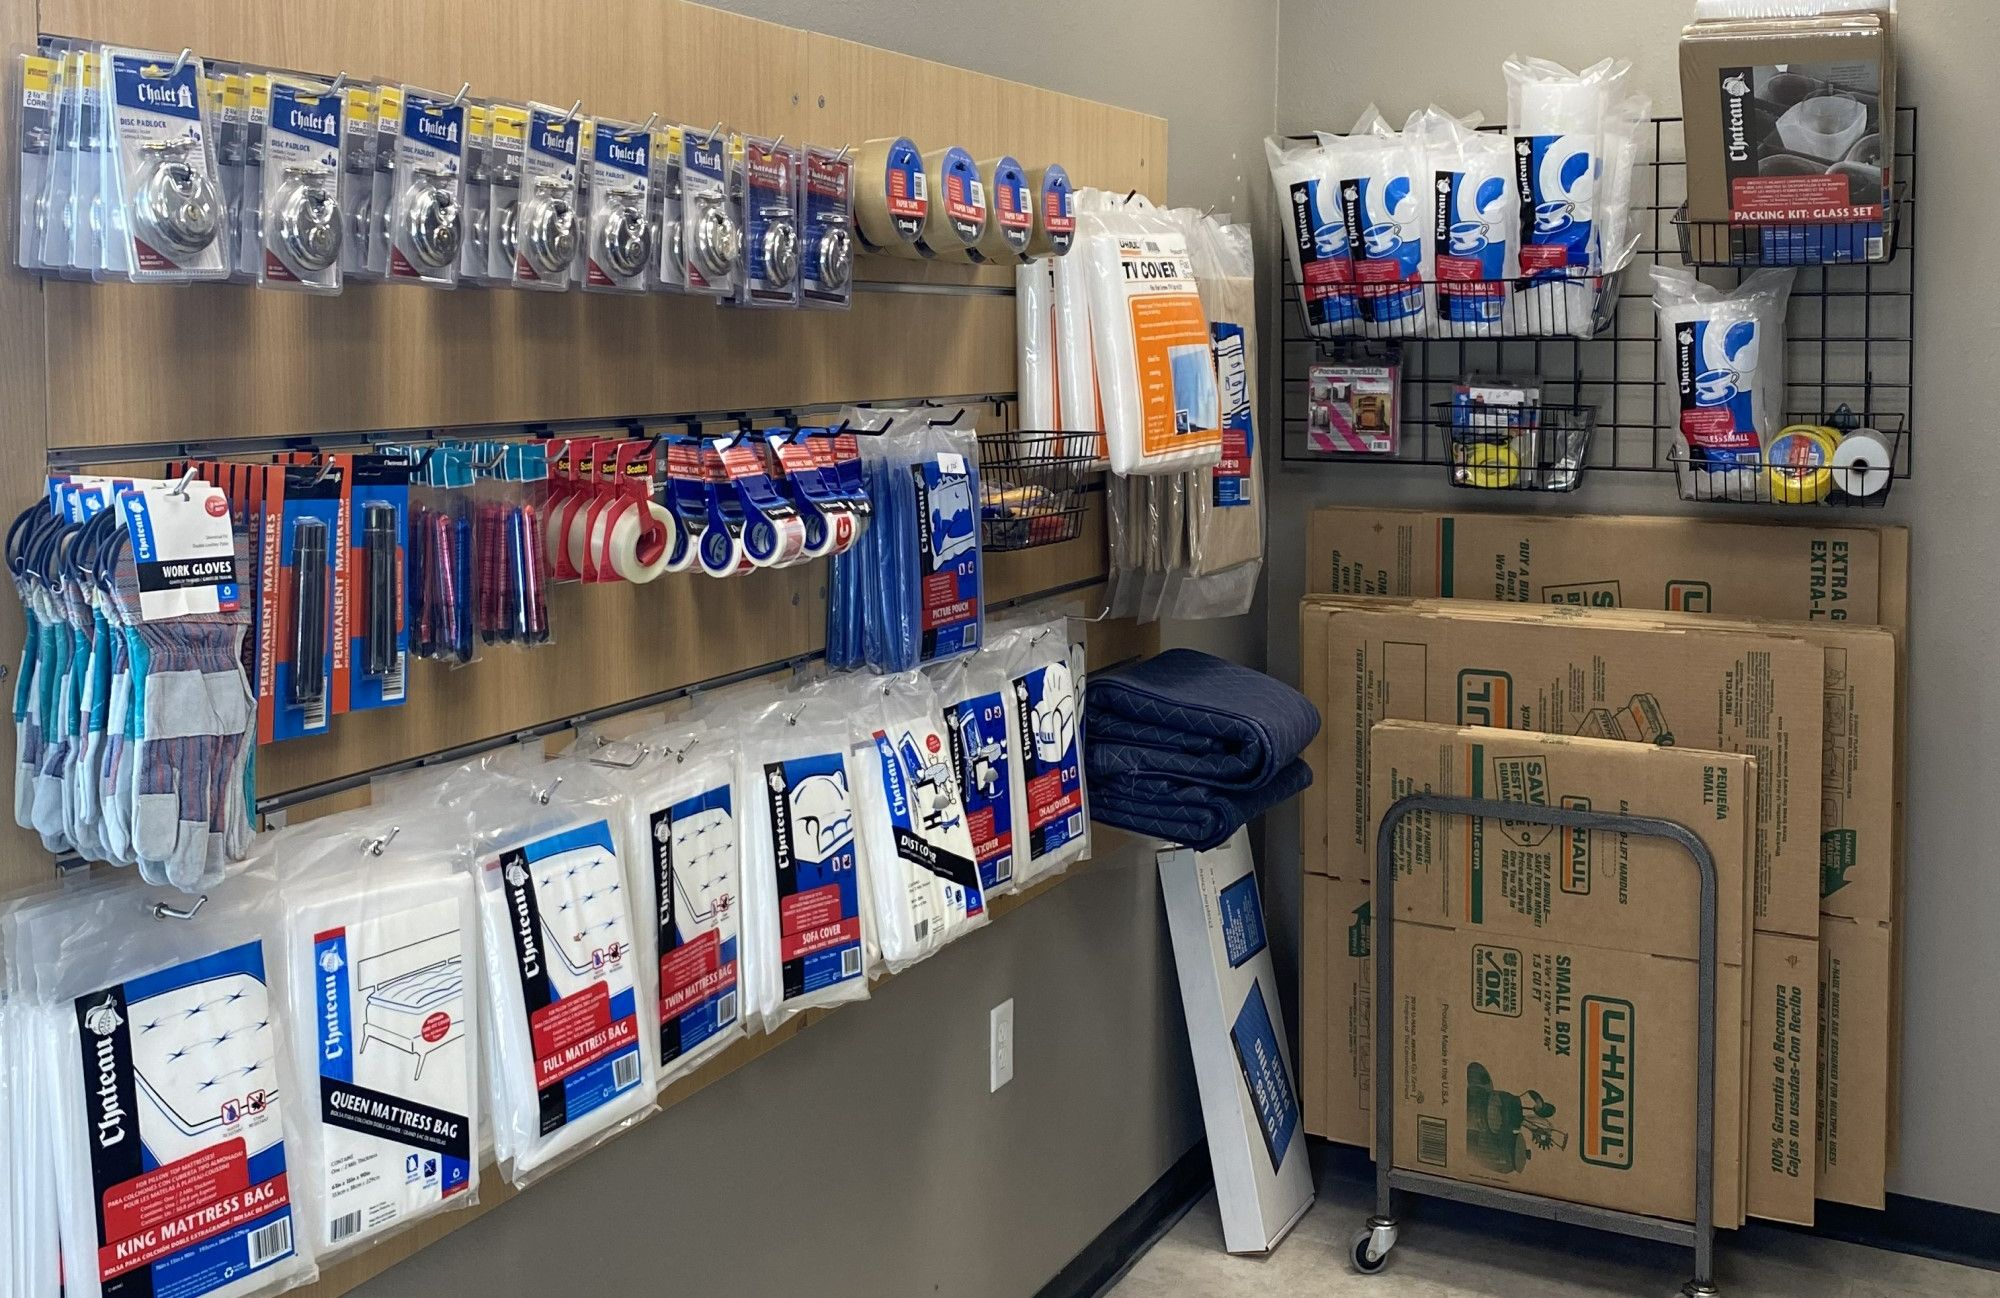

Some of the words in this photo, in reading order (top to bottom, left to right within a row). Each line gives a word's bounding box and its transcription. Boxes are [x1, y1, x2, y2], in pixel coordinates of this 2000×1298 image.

[138, 83, 177, 102] Chalet
[120, 117, 136, 126] DISC
[137, 119, 167, 128] PADLOCK
[290, 109, 322, 130] Chalet
[419, 117, 447, 136] Chalet
[1729, 98, 1749, 162] Chateau
[543, 132, 565, 150] Chalet
[609, 144, 635, 162] Chalet
[695, 152, 714, 167] Chalet
[1519, 156, 1531, 203] Chateau
[1298, 205, 1311, 250] Chateau
[1347, 202, 1360, 247] Chateau
[1436, 194, 1447, 240] Chateau
[1734, 210, 1785, 221] PACKING
[1788, 209, 1810, 219] KIT:
[1813, 208, 1850, 218] GLASS
[1853, 206, 1874, 217] SET
[1122, 262, 1139, 279] TV
[1141, 262, 1178, 279] COVER
[1681, 346, 1691, 394] Chateau
[627, 464, 648, 474] Scotch
[133, 513, 150, 560] Chateau
[335, 499, 345, 572] MARKERS
[922, 487, 930, 553] Chateau
[162, 564, 190, 578] WORK
[192, 561, 232, 576] GLOVES
[264, 513, 276, 594] MARKERS
[1496, 554, 1506, 581] We'll
[1831, 541, 1848, 602] EXTRA
[1508, 570, 1517, 591] Beat
[333, 577, 345, 670] PERMANENT
[932, 607, 951, 620] PICTURE
[951, 602, 969, 615] POUCH
[259, 598, 272, 697] PERMANENT
[1725, 671, 1733, 715] RECYCLE
[1021, 702, 1032, 761] Chateau
[887, 758, 907, 817] Chateau
[1355, 770, 1363, 787] ARE
[1509, 762, 1521, 789] BEST
[1703, 765, 1714, 805] SMALL
[1716, 767, 1728, 821] PEQUEÑA
[1355, 788, 1363, 813] BOXES
[774, 794, 790, 869] Chateau
[1501, 849, 1509, 868] FREE
[1535, 853, 1543, 875] SAVE
[660, 844, 670, 925] Chateau
[1517, 877, 1525, 893] and
[1535, 876, 1543, 898] EVEN
[1619, 862, 1628, 905] HANDLES
[514, 887, 540, 980] Chateau
[802, 928, 819, 945] SOFA
[819, 924, 841, 941] COVER
[1476, 949, 1484, 966] FOR
[1532, 953, 1541, 968] 1.5
[665, 992, 684, 1009] TWIN
[684, 974, 718, 1002] MATTRESS
[718, 965, 733, 985] BAG
[1476, 968, 1484, 1007] SHIPPING
[1485, 971, 1501, 1009] OK
[1532, 970, 1541, 984] CU
[1532, 987, 1541, 1002] FT
[1555, 955, 1571, 1015] SMALL
[325, 975, 344, 1061] Chateau
[1440, 1003, 1449, 1033] Proudly
[1773, 984, 1787, 1054] Recompra
[1788, 986, 1802, 1039] Recibo
[543, 1056, 565, 1074] FULL
[566, 1033, 607, 1061] MATTRESS
[608, 1022, 629, 1043] BAG
[1556, 1021, 1571, 1057] BOX
[1441, 1068, 1449, 1080] the
[1442, 1058, 1449, 1067] in
[1775, 1056, 1785, 1072] de
[97, 1036, 126, 1149] Chateau
[1254, 1038, 1284, 1127] WRAPPING
[1271, 1055, 1290, 1111] PAPER
[1601, 1010, 1626, 1156] U-HAUL
[330, 1090, 370, 1115] QUEEN
[371, 1097, 432, 1131] MATTRESS
[433, 1115, 458, 1139] BAG
[1791, 1122, 1800, 1138] no
[1771, 1137, 1785, 1174] 100%
[1786, 1145, 1801, 1178] Cajas
[149, 1171, 170, 1183] PILLOW
[172, 1167, 182, 1175] TOP
[107, 1197, 123, 1207] PARA
[104, 1264, 124, 1276] BOLSA
[125, 1257, 141, 1268] PARA
[171, 1236, 190, 1248] DOBLE
[264, 1196, 287, 1210] MATELAS
[116, 1233, 157, 1260] KING
[161, 1199, 240, 1246] MATTRESS
[243, 1183, 274, 1209] BAG
